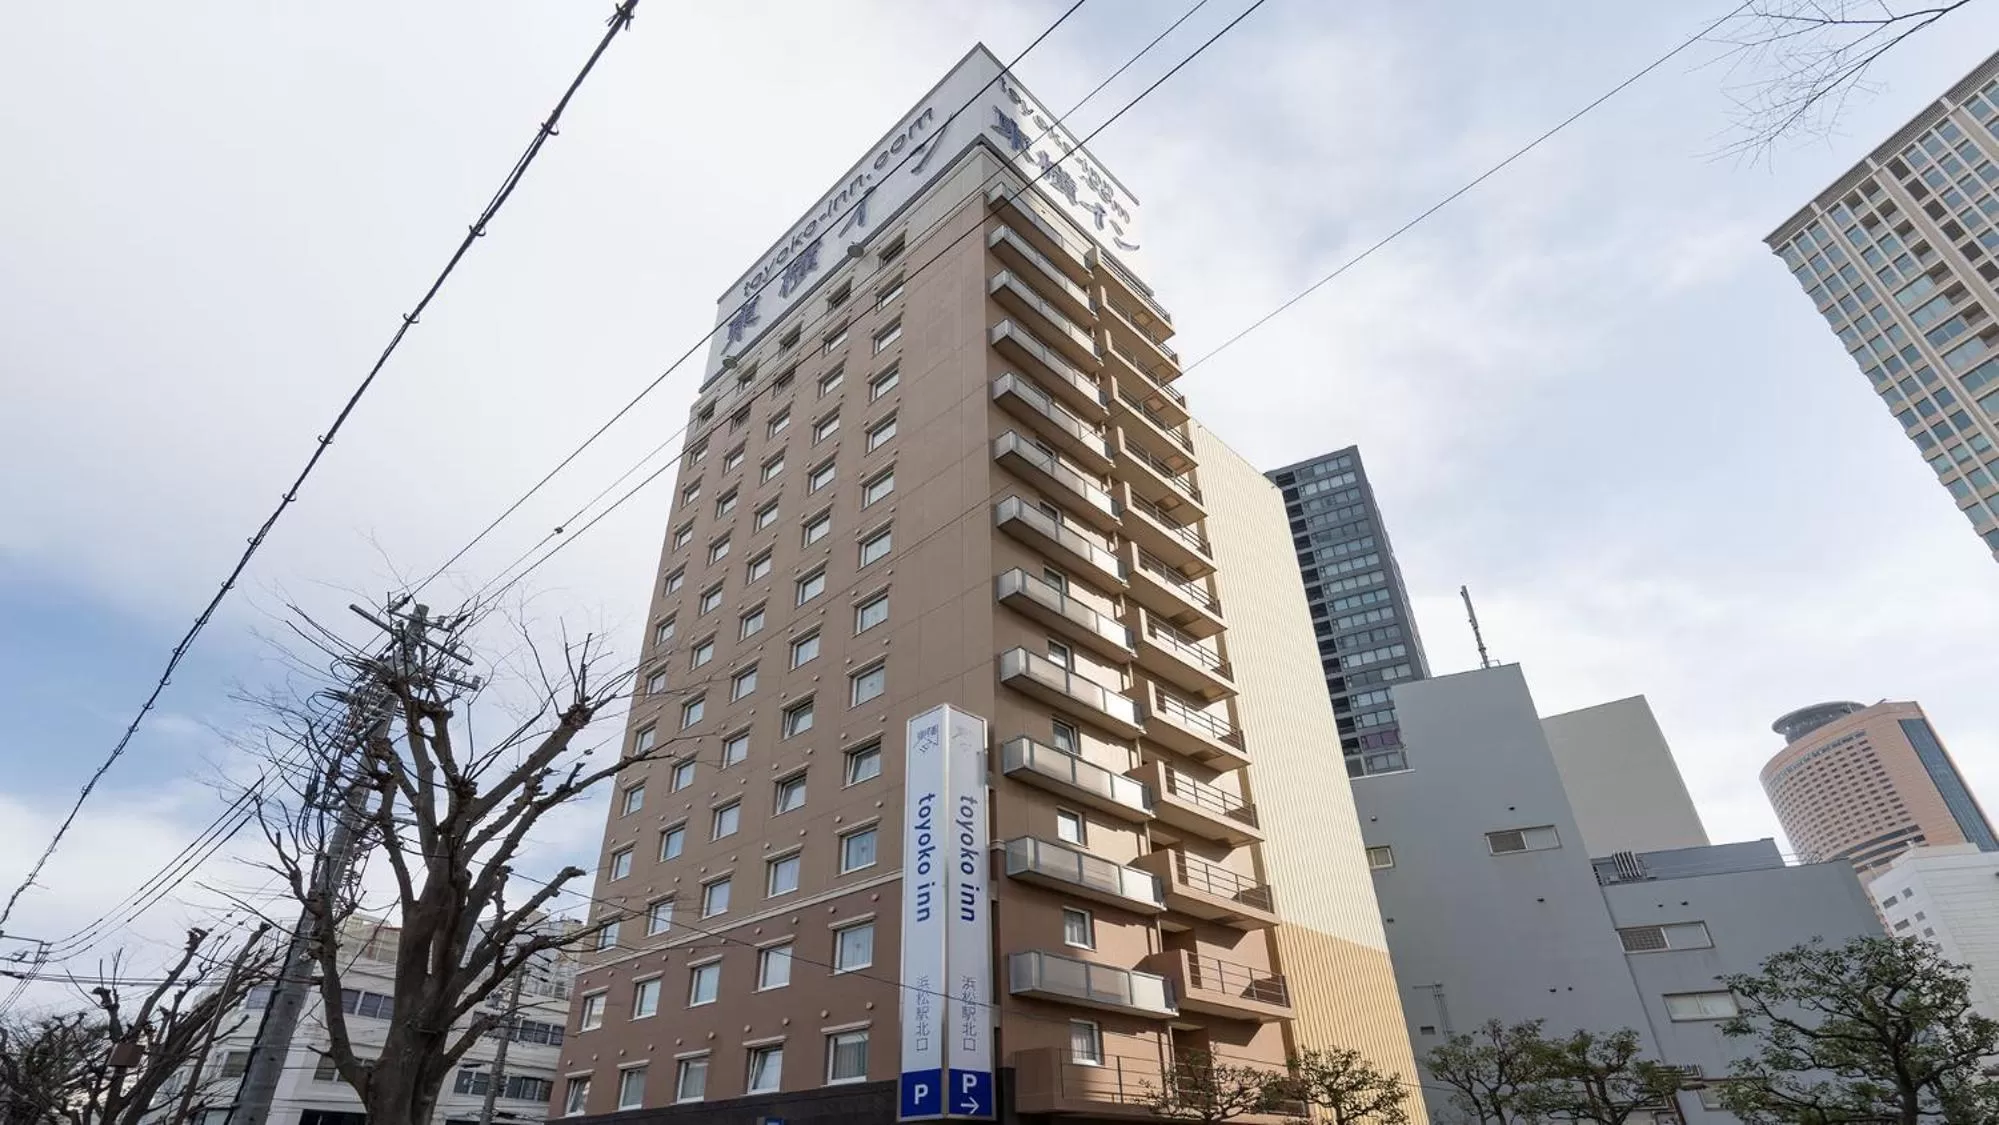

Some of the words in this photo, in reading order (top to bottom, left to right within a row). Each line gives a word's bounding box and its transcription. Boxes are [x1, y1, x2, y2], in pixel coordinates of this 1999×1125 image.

[744, 107, 933, 297] toyoko-inn.com
[914, 793, 936, 875] toyoko
[956, 795, 979, 875] toyoko
[916, 881, 936, 922] inn
[961, 883, 980, 922] inn
[916, 975, 930, 1051] 浜松駅北口
[961, 975, 977, 1051] 浜松駅北口
[914, 1084, 929, 1105] P
[962, 1073, 977, 1094] P
